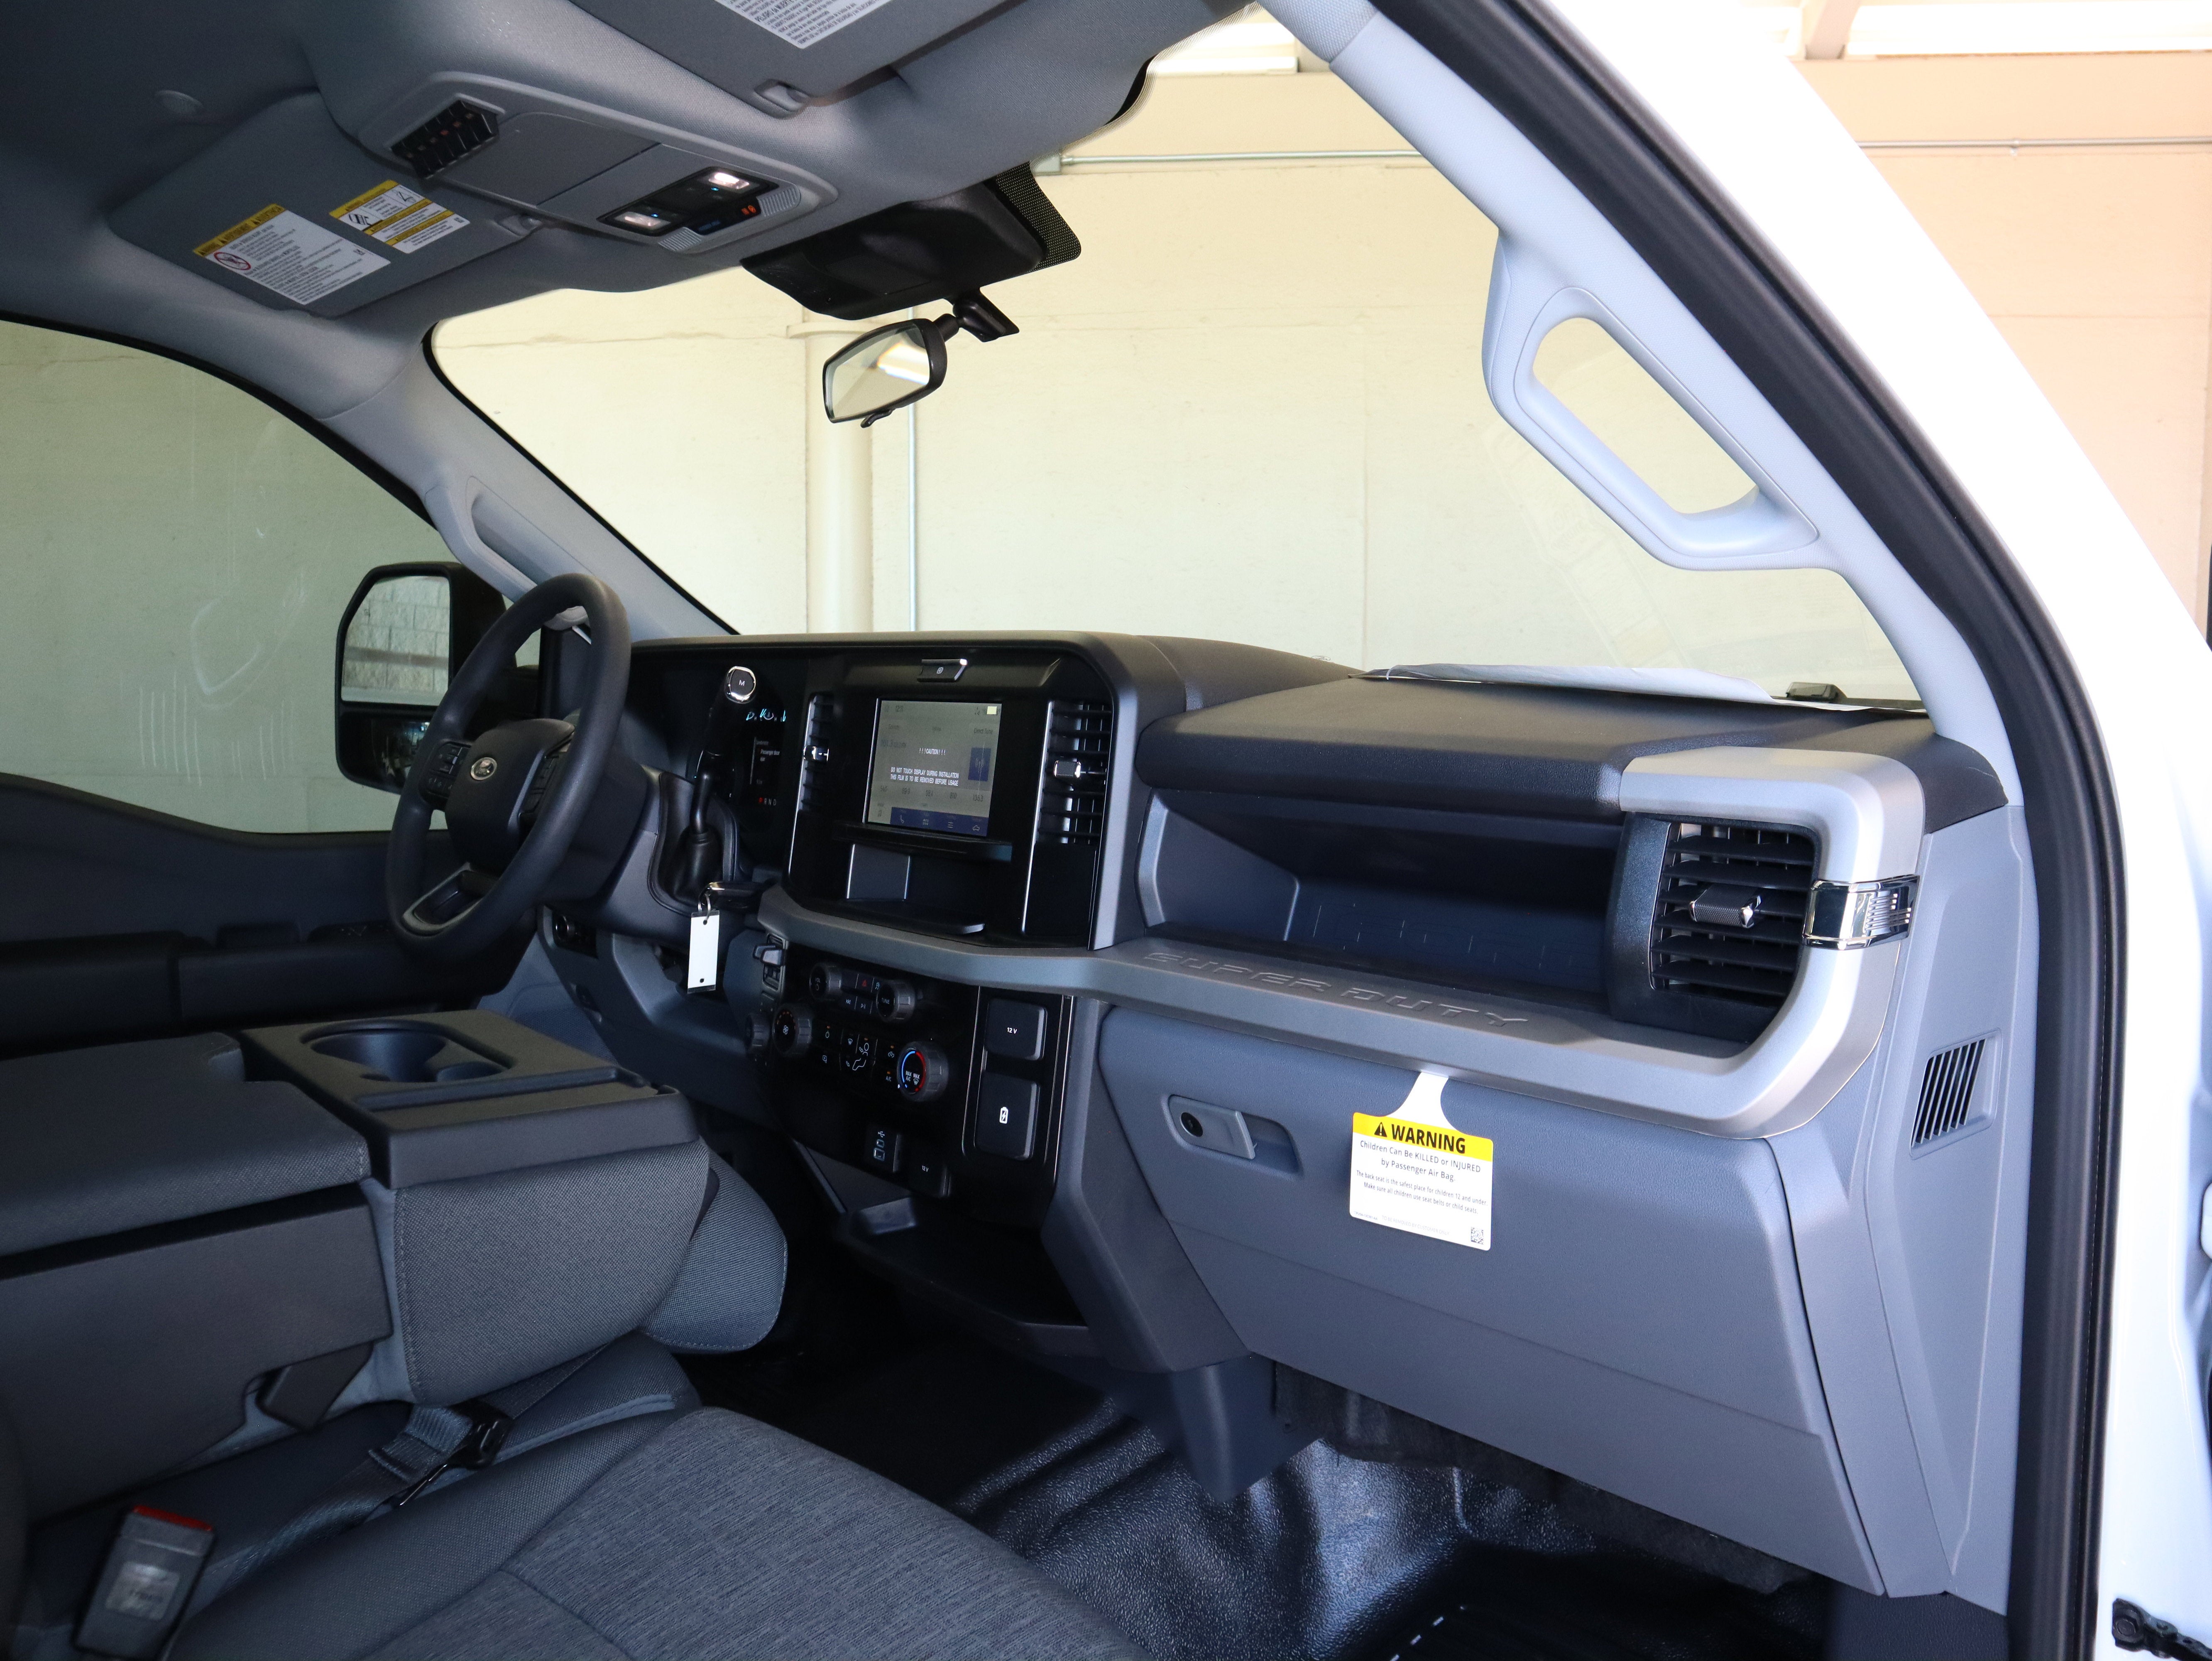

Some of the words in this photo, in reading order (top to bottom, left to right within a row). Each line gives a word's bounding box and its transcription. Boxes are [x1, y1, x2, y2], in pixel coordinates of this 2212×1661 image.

[1144, 952, 1332, 992] SUPER
[1341, 987, 1528, 1027] DUTY
[1391, 1124, 1466, 1154] WARNING
[1360, 1140, 1387, 1153] Children
[1389, 1147, 1402, 1156] Can
[1405, 1150, 1413, 1158] Be
[1415, 1152, 1439, 1164] KILLED
[1451, 1160, 1481, 1173] INJURED
[1381, 1158, 1390, 1168] by
[1391, 1160, 1427, 1175] Passenger
[1428, 1169, 1439, 1177] Air
[1441, 1171, 1456, 1183] Bag.
[1364, 1181, 1375, 1190] Make
[1394, 1189, 1412, 1199] children
[1433, 1198, 1444, 1206] belts
[1465, 1206, 1478, 1214] seats.
[1435, 1188, 1453, 1198] children
[1472, 1198, 1488, 1206] under.
[1393, 1218, 1411, 1227] REMOVED
[1417, 1224, 1438, 1233] CUSTOMER
